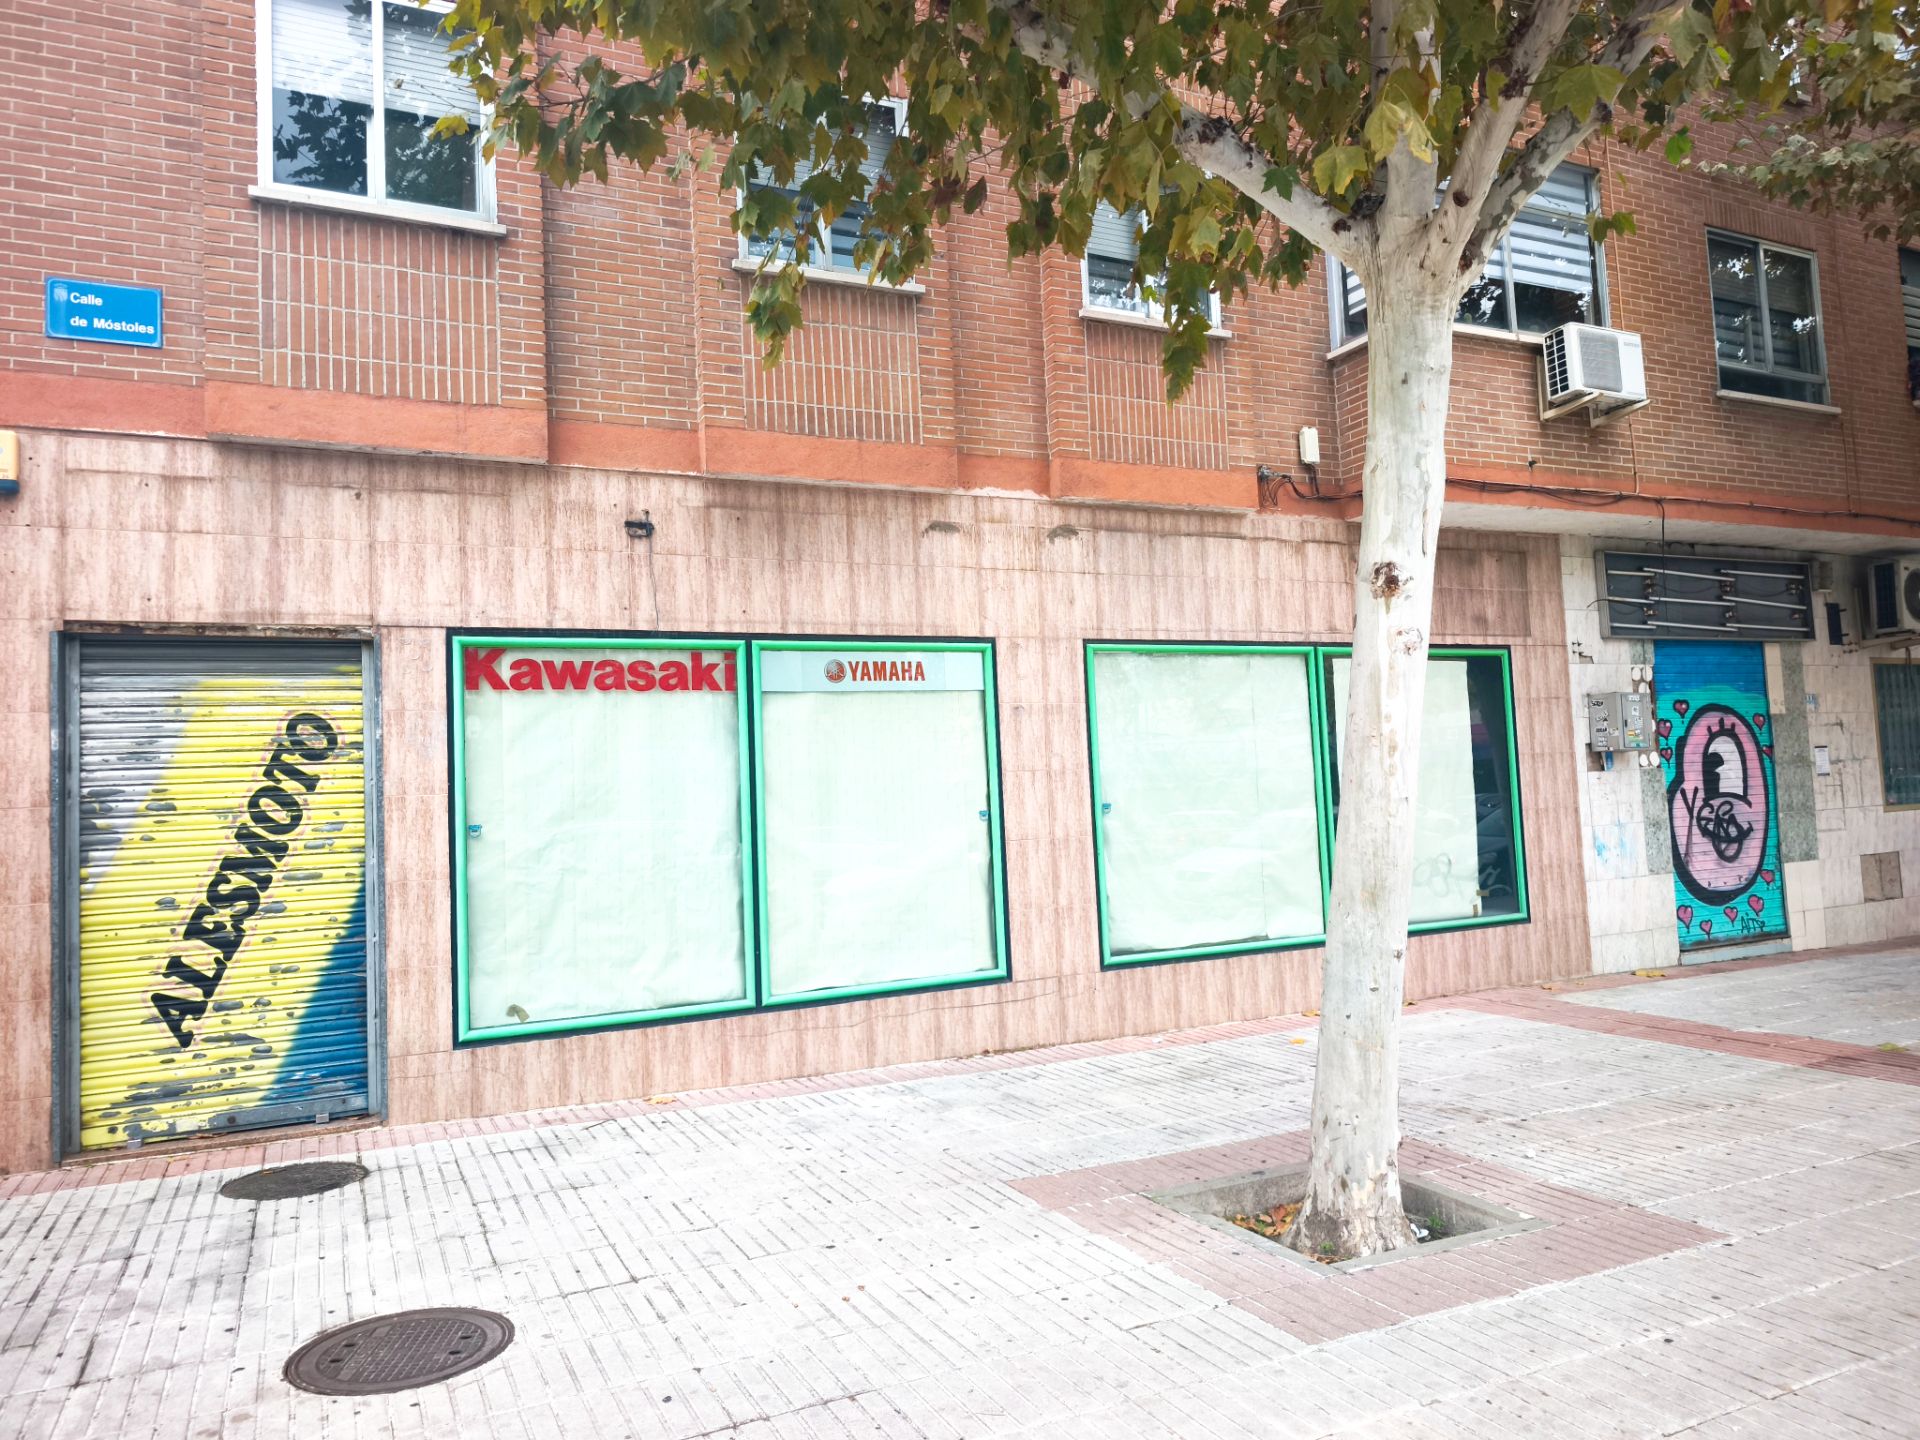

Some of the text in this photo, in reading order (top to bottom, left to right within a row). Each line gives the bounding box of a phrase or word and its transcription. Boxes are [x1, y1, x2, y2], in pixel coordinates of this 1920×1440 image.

[70, 292, 103, 306] Calle
[70, 316, 155, 334] de Móstoles
[464, 647, 737, 692] Kawasaki
[847, 660, 926, 682] YAMAHA
[150, 712, 339, 1049] ALESMOTO
